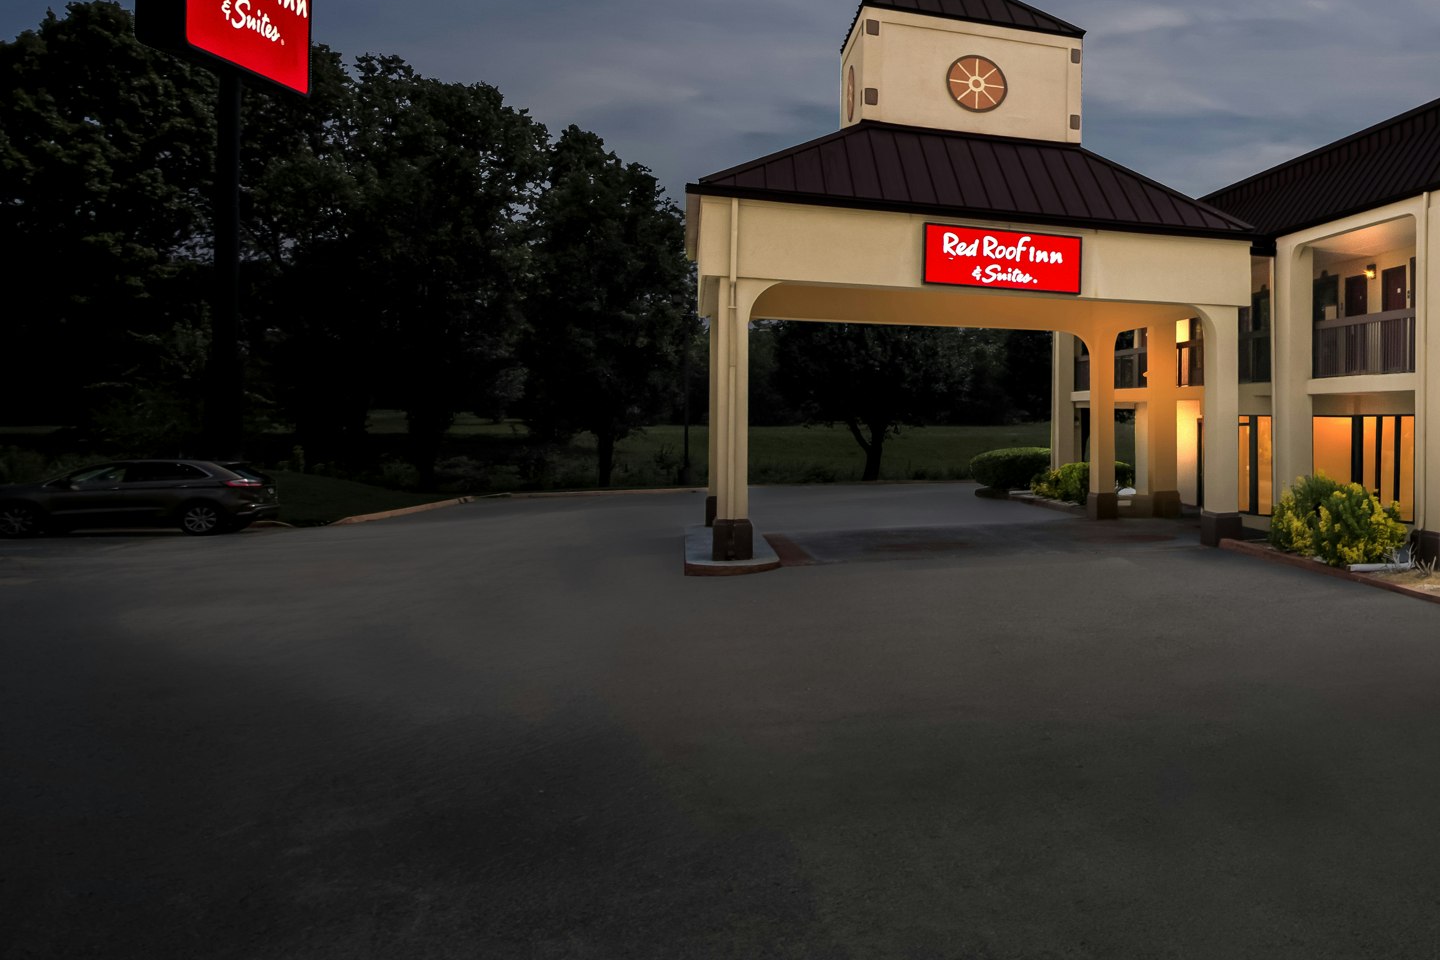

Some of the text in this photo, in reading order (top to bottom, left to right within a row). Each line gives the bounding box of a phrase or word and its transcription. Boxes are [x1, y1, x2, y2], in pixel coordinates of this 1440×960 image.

[942, 232, 1064, 265] Red Roof Inn
[971, 265, 983, 281] &
